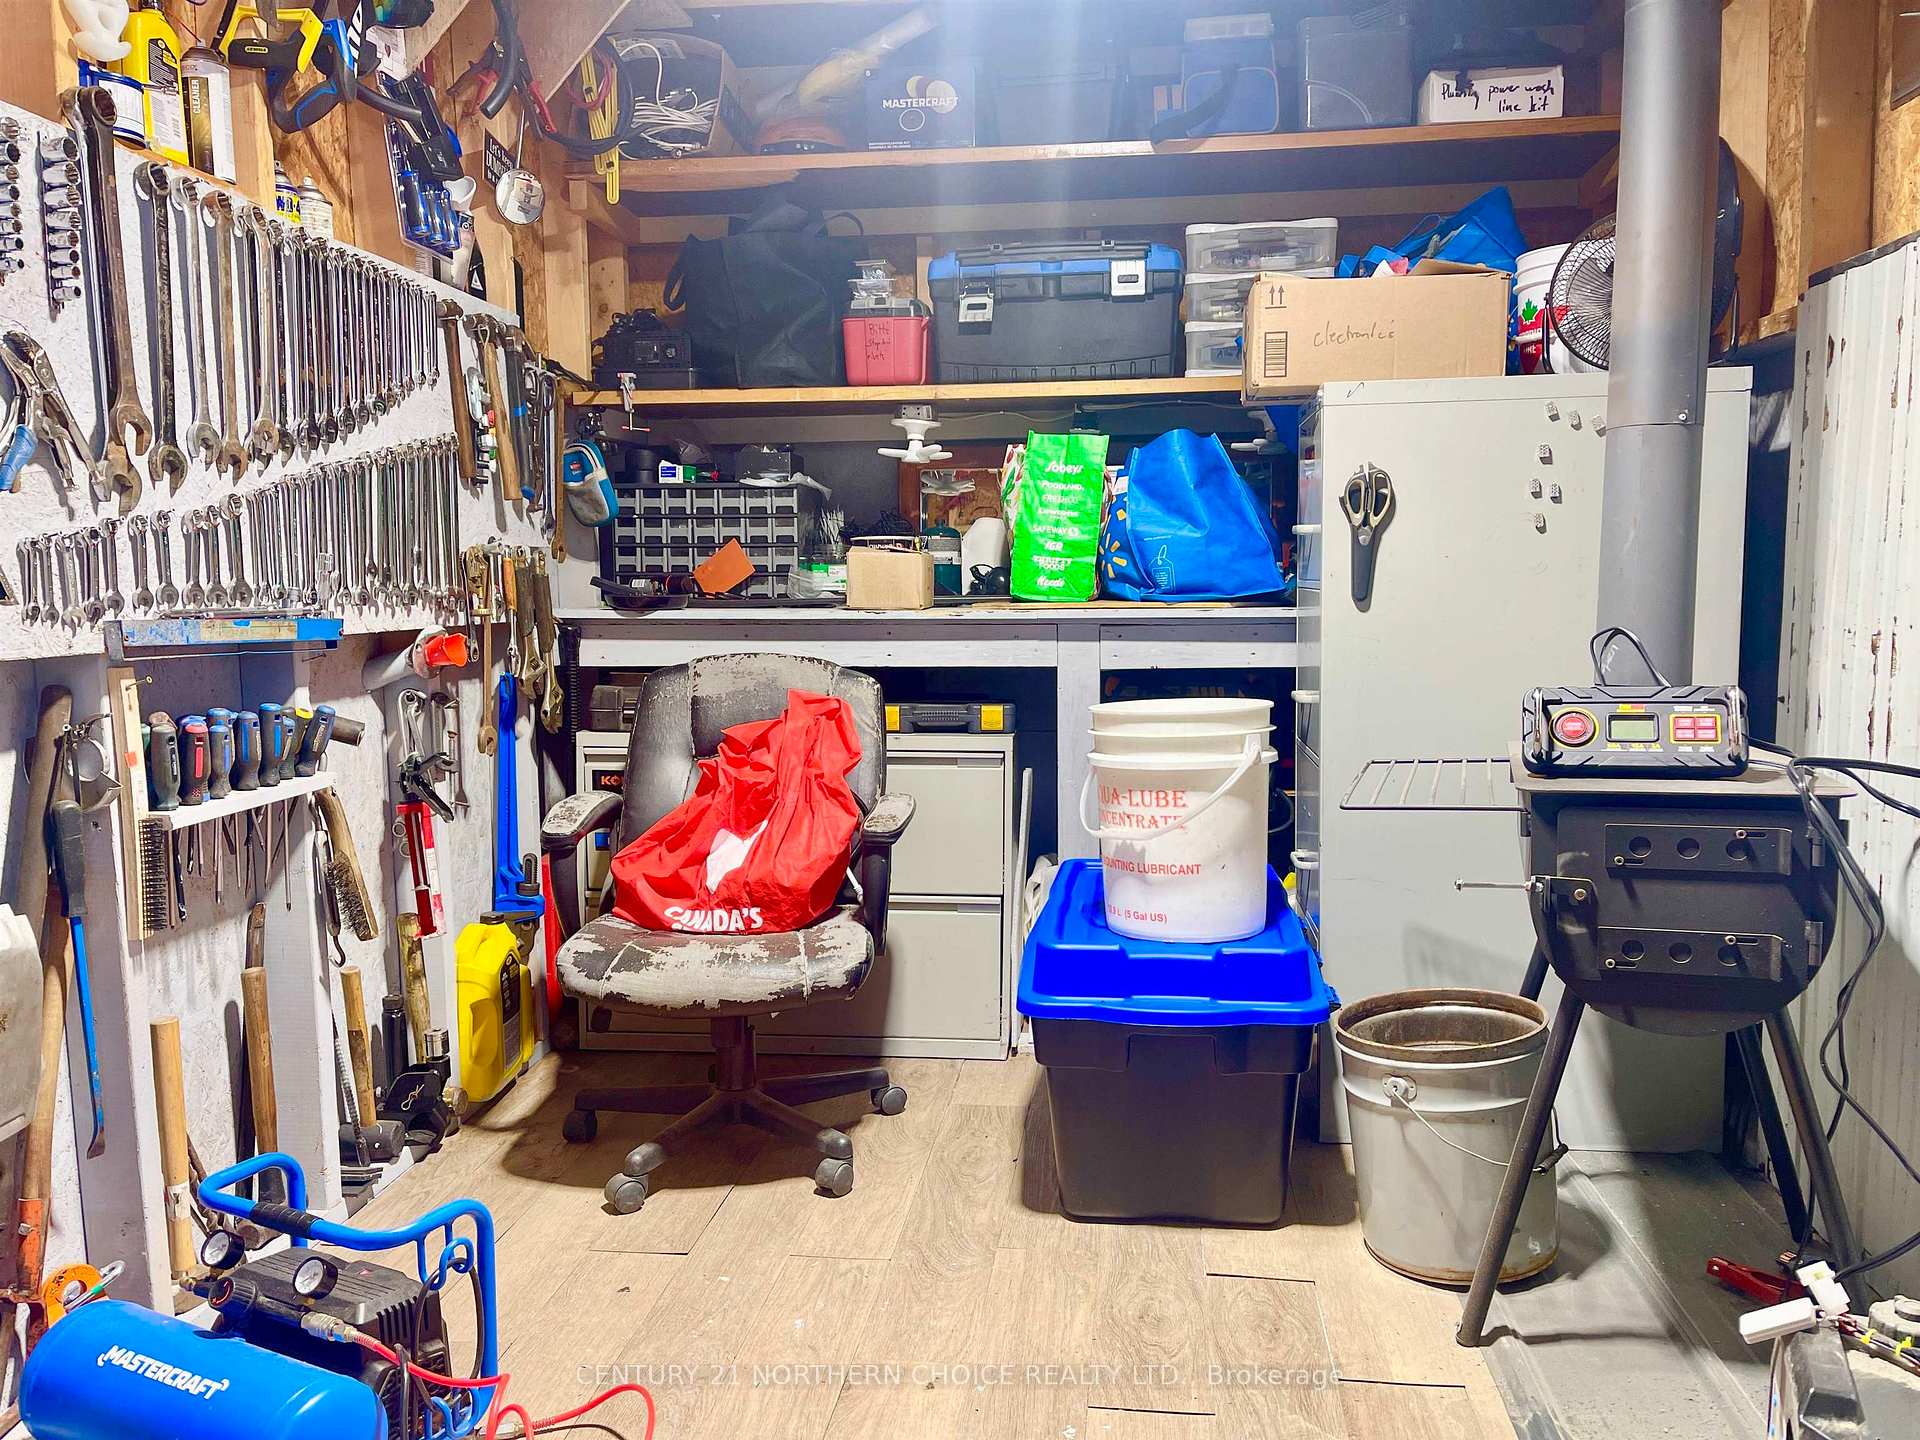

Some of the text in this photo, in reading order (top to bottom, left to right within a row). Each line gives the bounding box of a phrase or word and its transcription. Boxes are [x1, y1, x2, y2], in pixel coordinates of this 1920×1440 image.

[192, 79, 200, 114] CLEANER
[1488, 84, 1520, 102] power
[882, 96, 959, 109] MASTERCRAFT
[1498, 95, 1549, 113] line kit
[1313, 319, 1397, 348] electronics
[1045, 461, 1083, 475] Sobeys
[601, 776, 624, 786] KO
[1137, 861, 1201, 875] LUBRICANT
[664, 906, 764, 932] CANADA'S
[1133, 909, 1148, 921] Gal
[1150, 912, 1168, 924] US)
[101, 1344, 224, 1400] MASTERCRAFT
